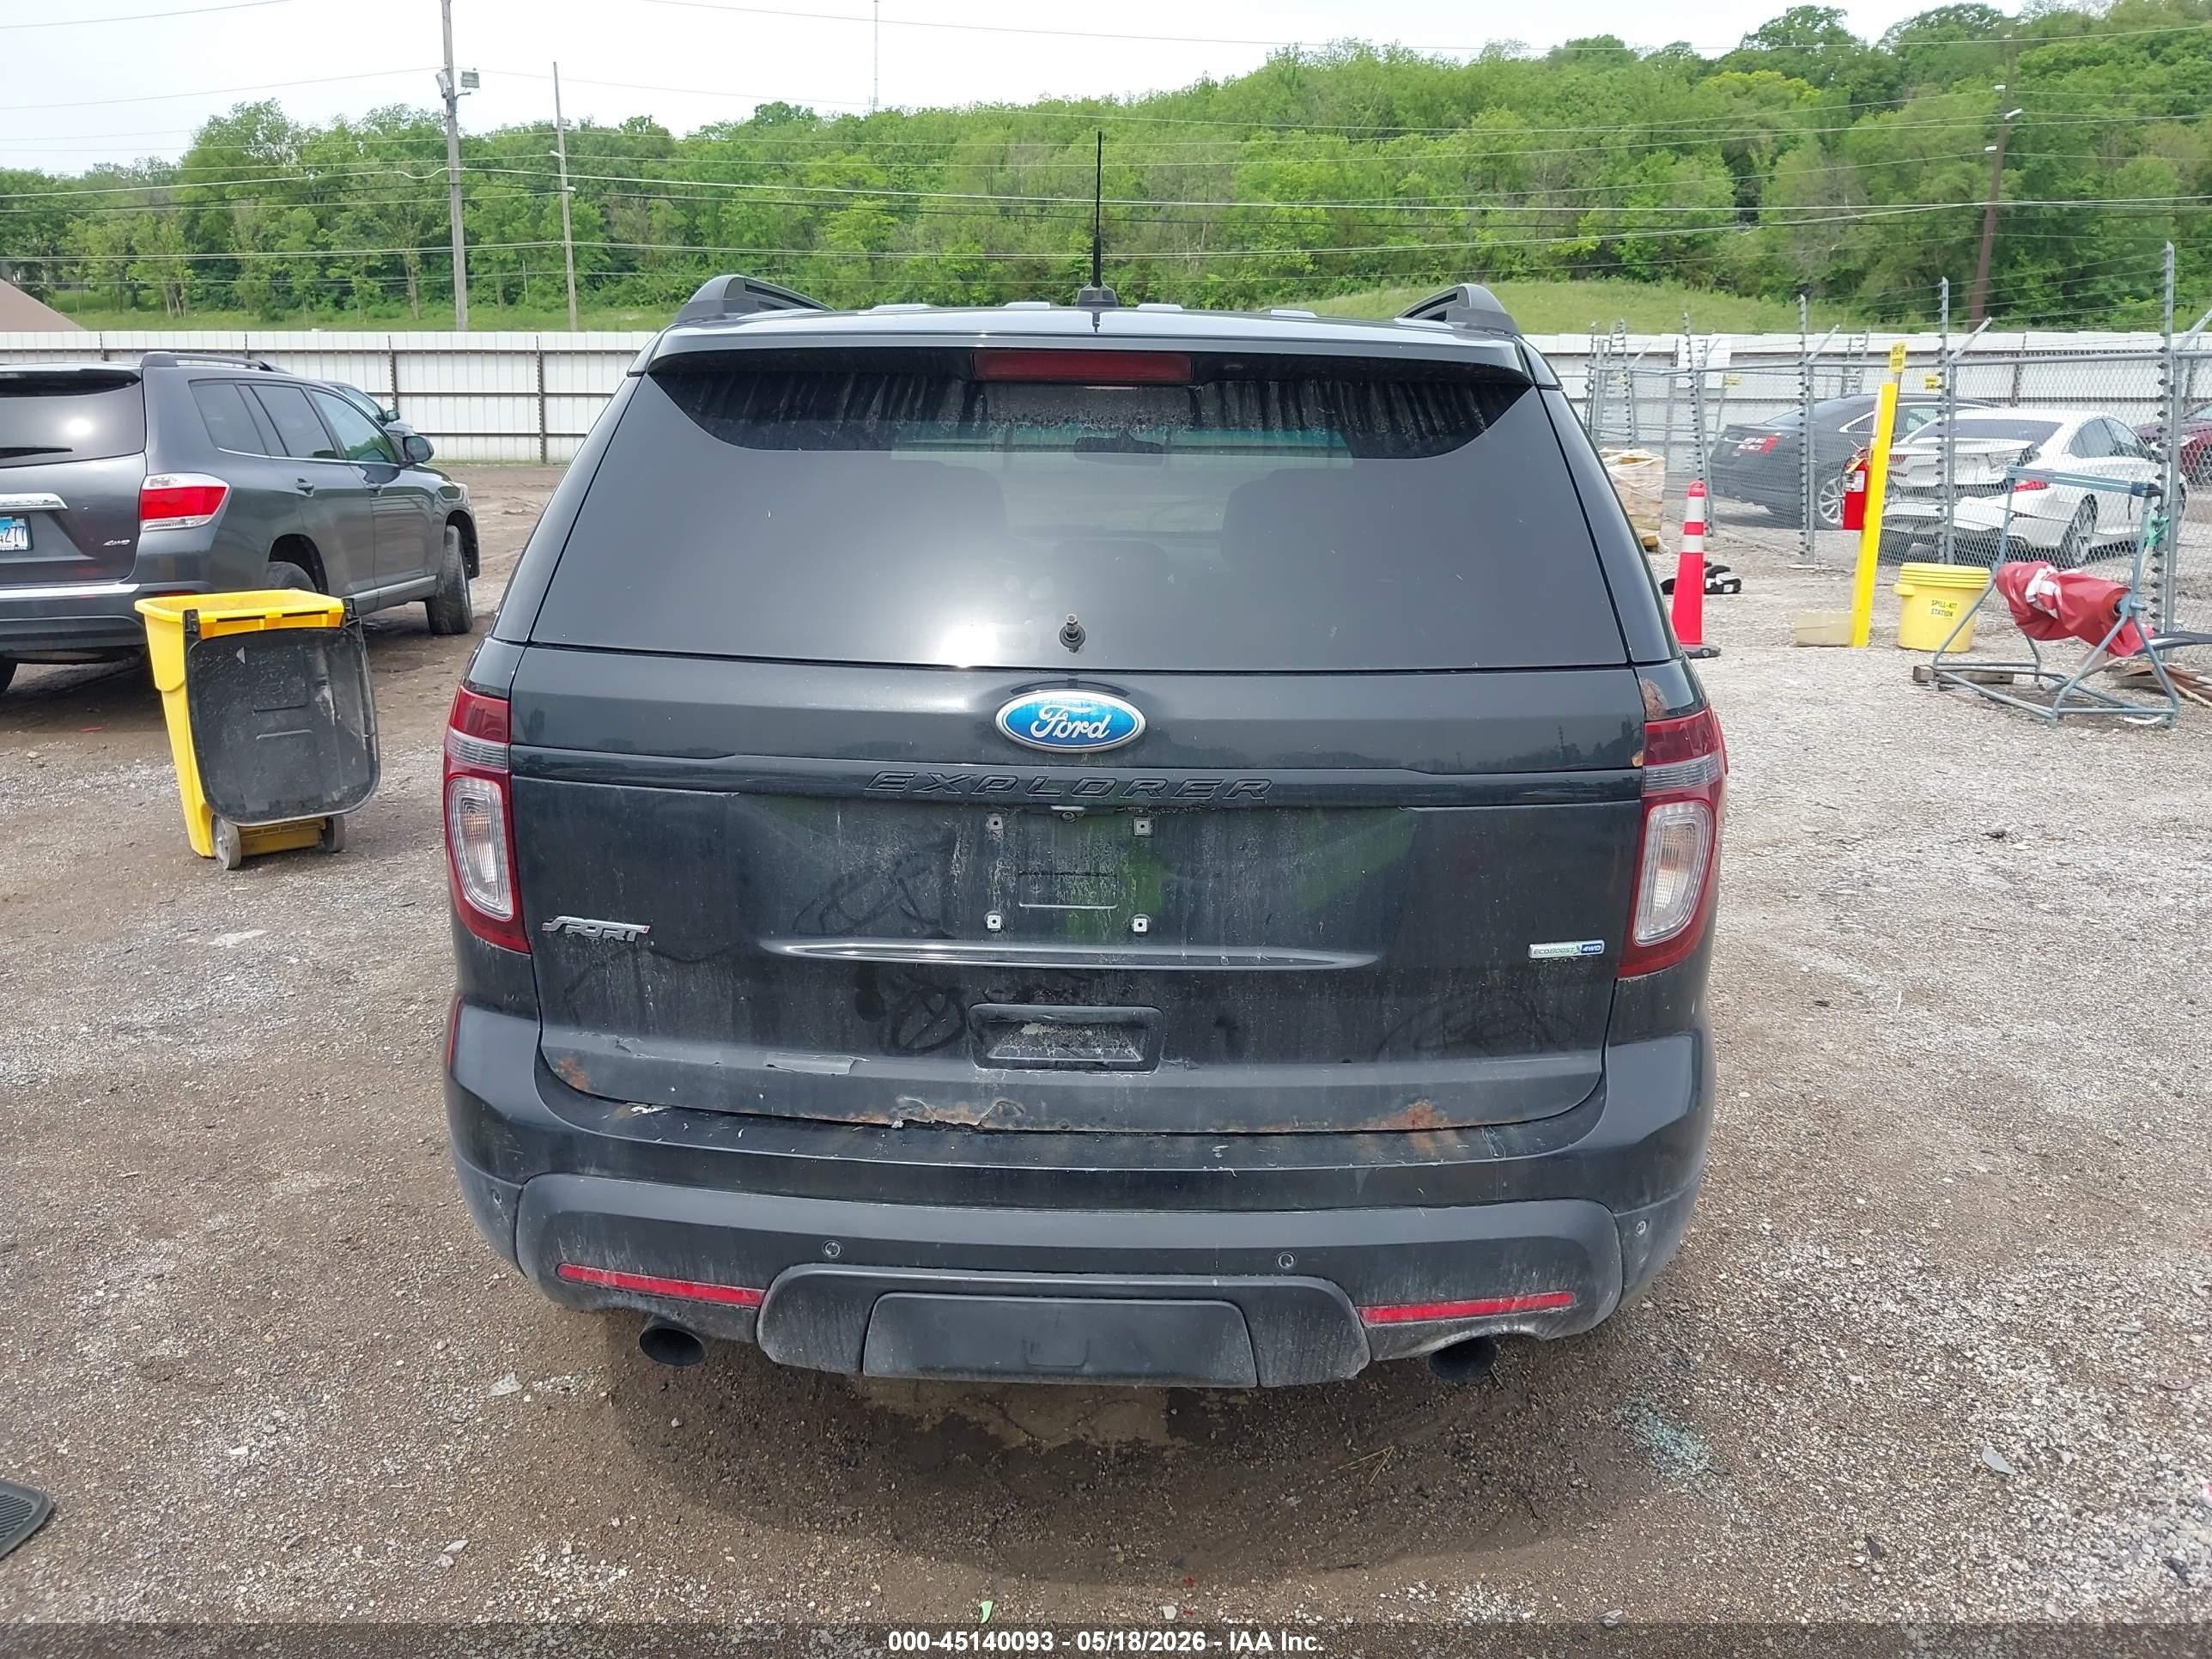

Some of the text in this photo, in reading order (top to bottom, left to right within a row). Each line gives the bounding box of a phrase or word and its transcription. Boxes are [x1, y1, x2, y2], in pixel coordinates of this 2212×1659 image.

[1930, 608, 1954, 617] STATION
[1030, 704, 1113, 738] Ford
[864, 770, 1274, 799] EXPLORER
[542, 915, 651, 942] SPORT
